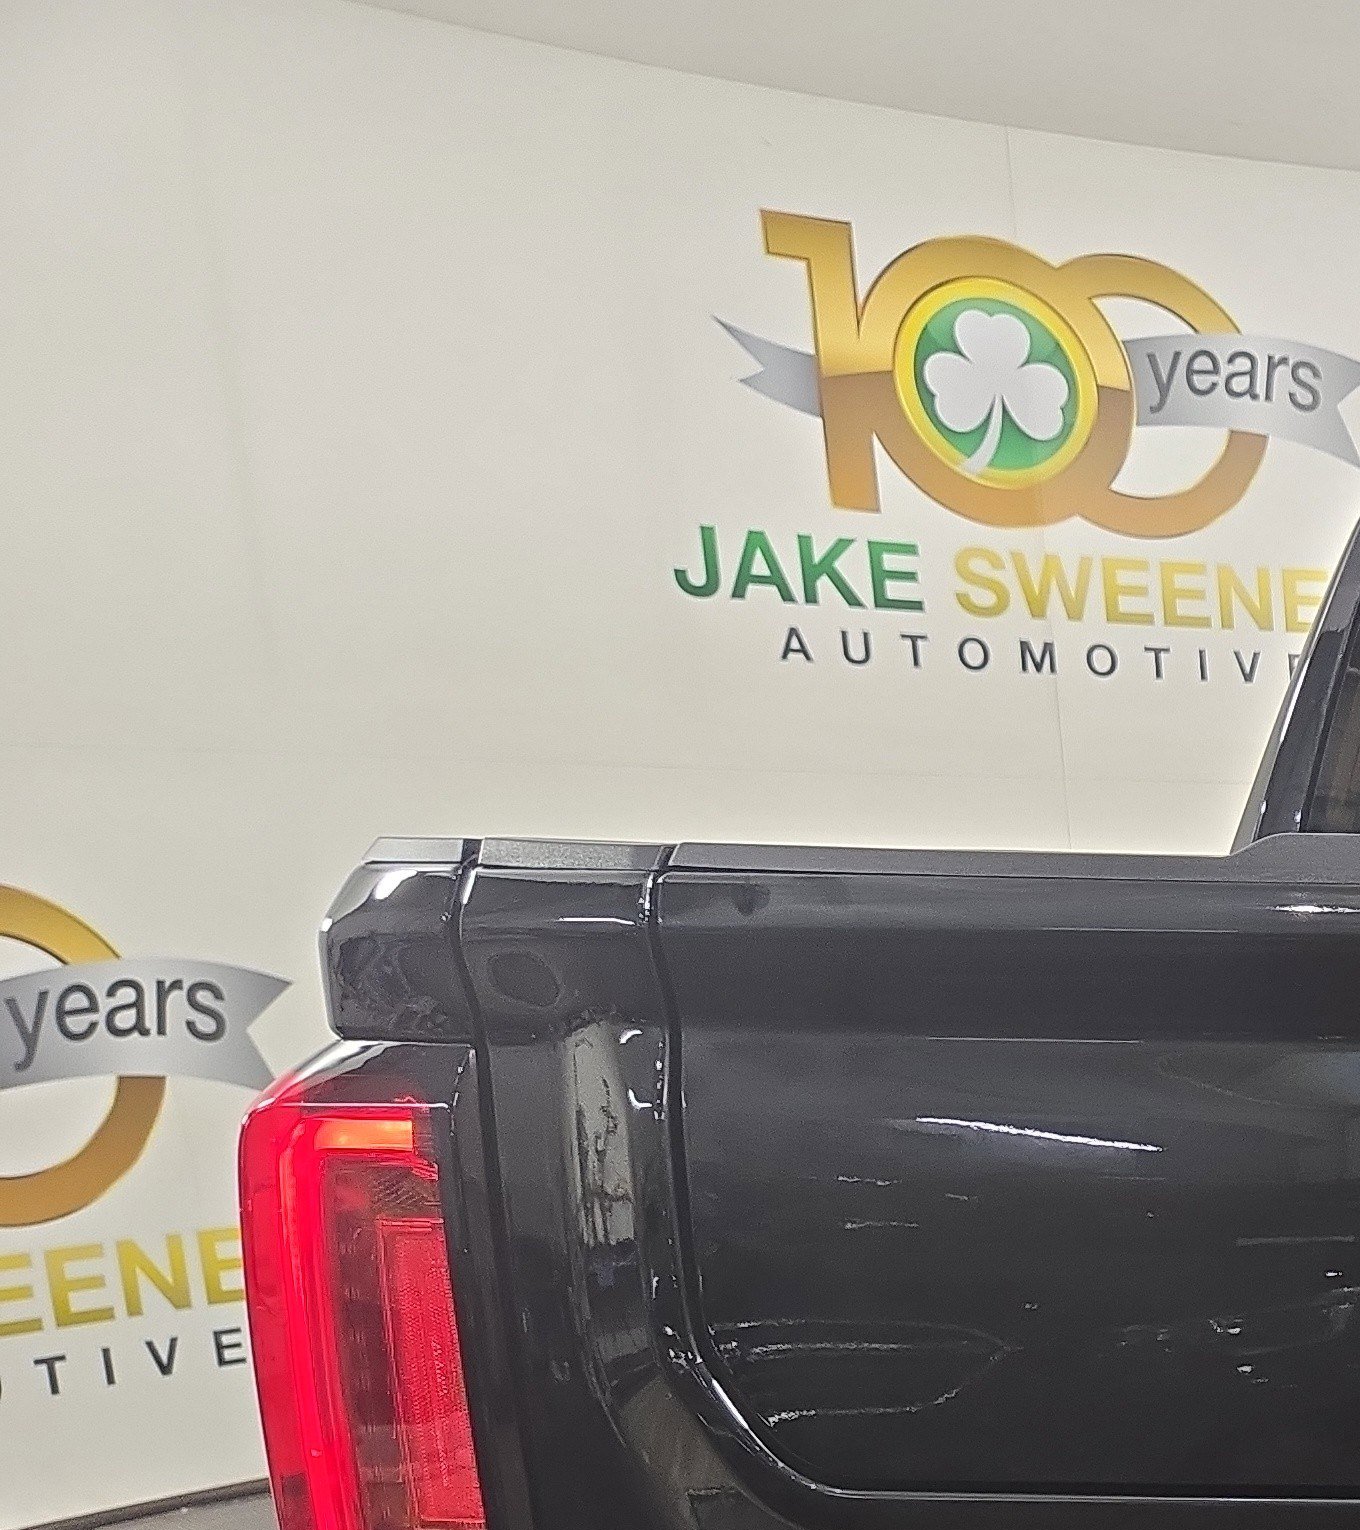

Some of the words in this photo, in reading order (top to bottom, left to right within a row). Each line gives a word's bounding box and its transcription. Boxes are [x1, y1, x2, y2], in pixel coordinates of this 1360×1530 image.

[1146, 347, 1324, 414] years
[674, 525, 926, 614] JAKE
[954, 546, 1329, 633] SWEENE
[4, 973, 227, 1073] years
[0, 1227, 246, 1336] EENE
